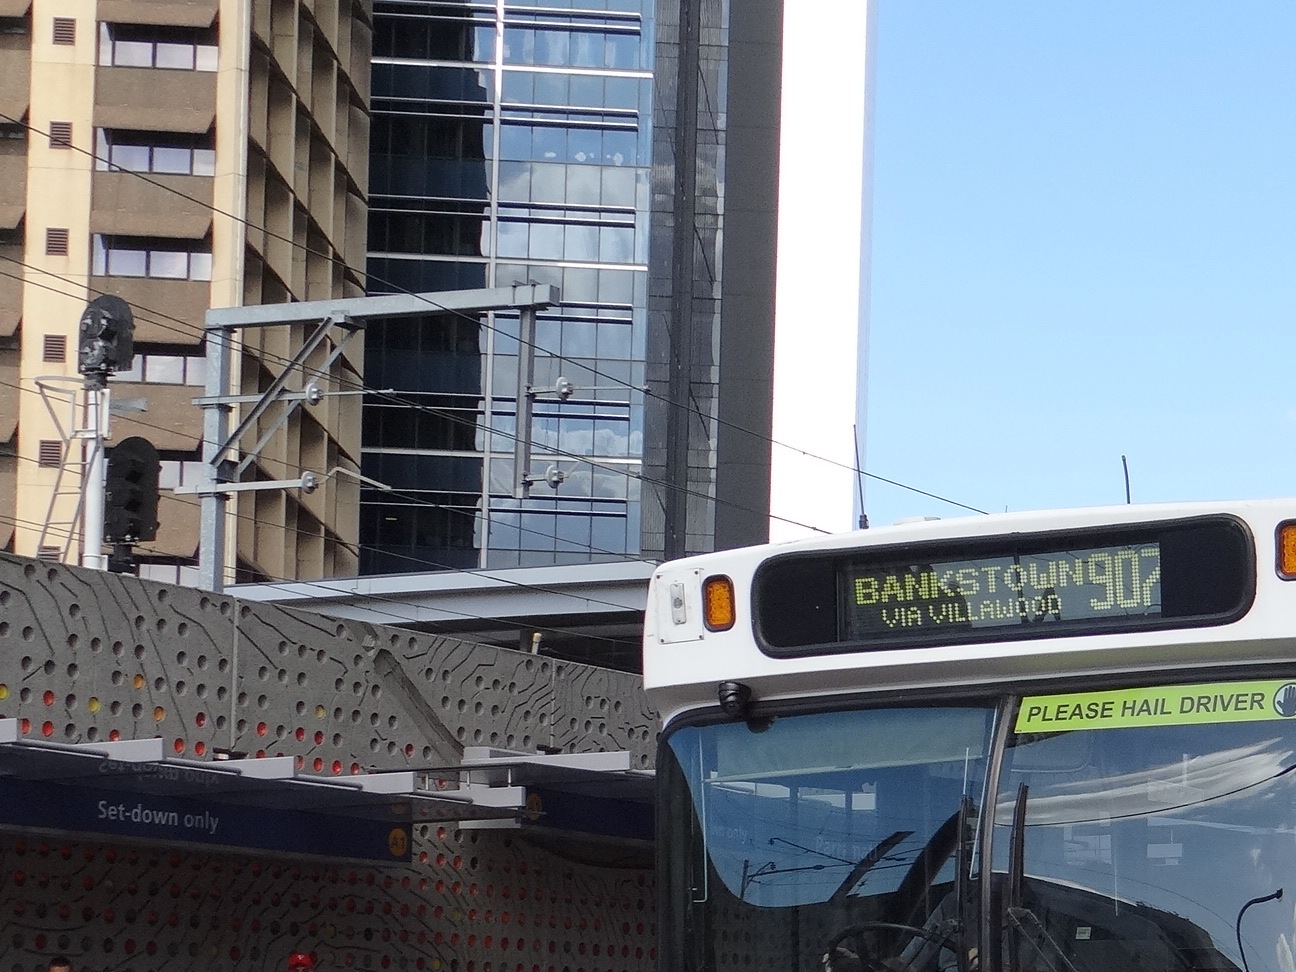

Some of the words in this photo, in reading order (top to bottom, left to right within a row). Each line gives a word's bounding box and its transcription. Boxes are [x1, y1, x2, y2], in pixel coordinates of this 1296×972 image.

[854, 558, 1084, 605] BANKSTOWN
[1088, 547, 1160, 611] 907
[882, 606, 922, 628] VIA
[928, 594, 1062, 623] VILLAWOOD
[1026, 701, 1115, 723] PLEASE
[1120, 698, 1172, 717] HAIL
[1178, 692, 1266, 714] DRIVER
[98, 800, 179, 826] Set-down
[184, 811, 219, 835] only
